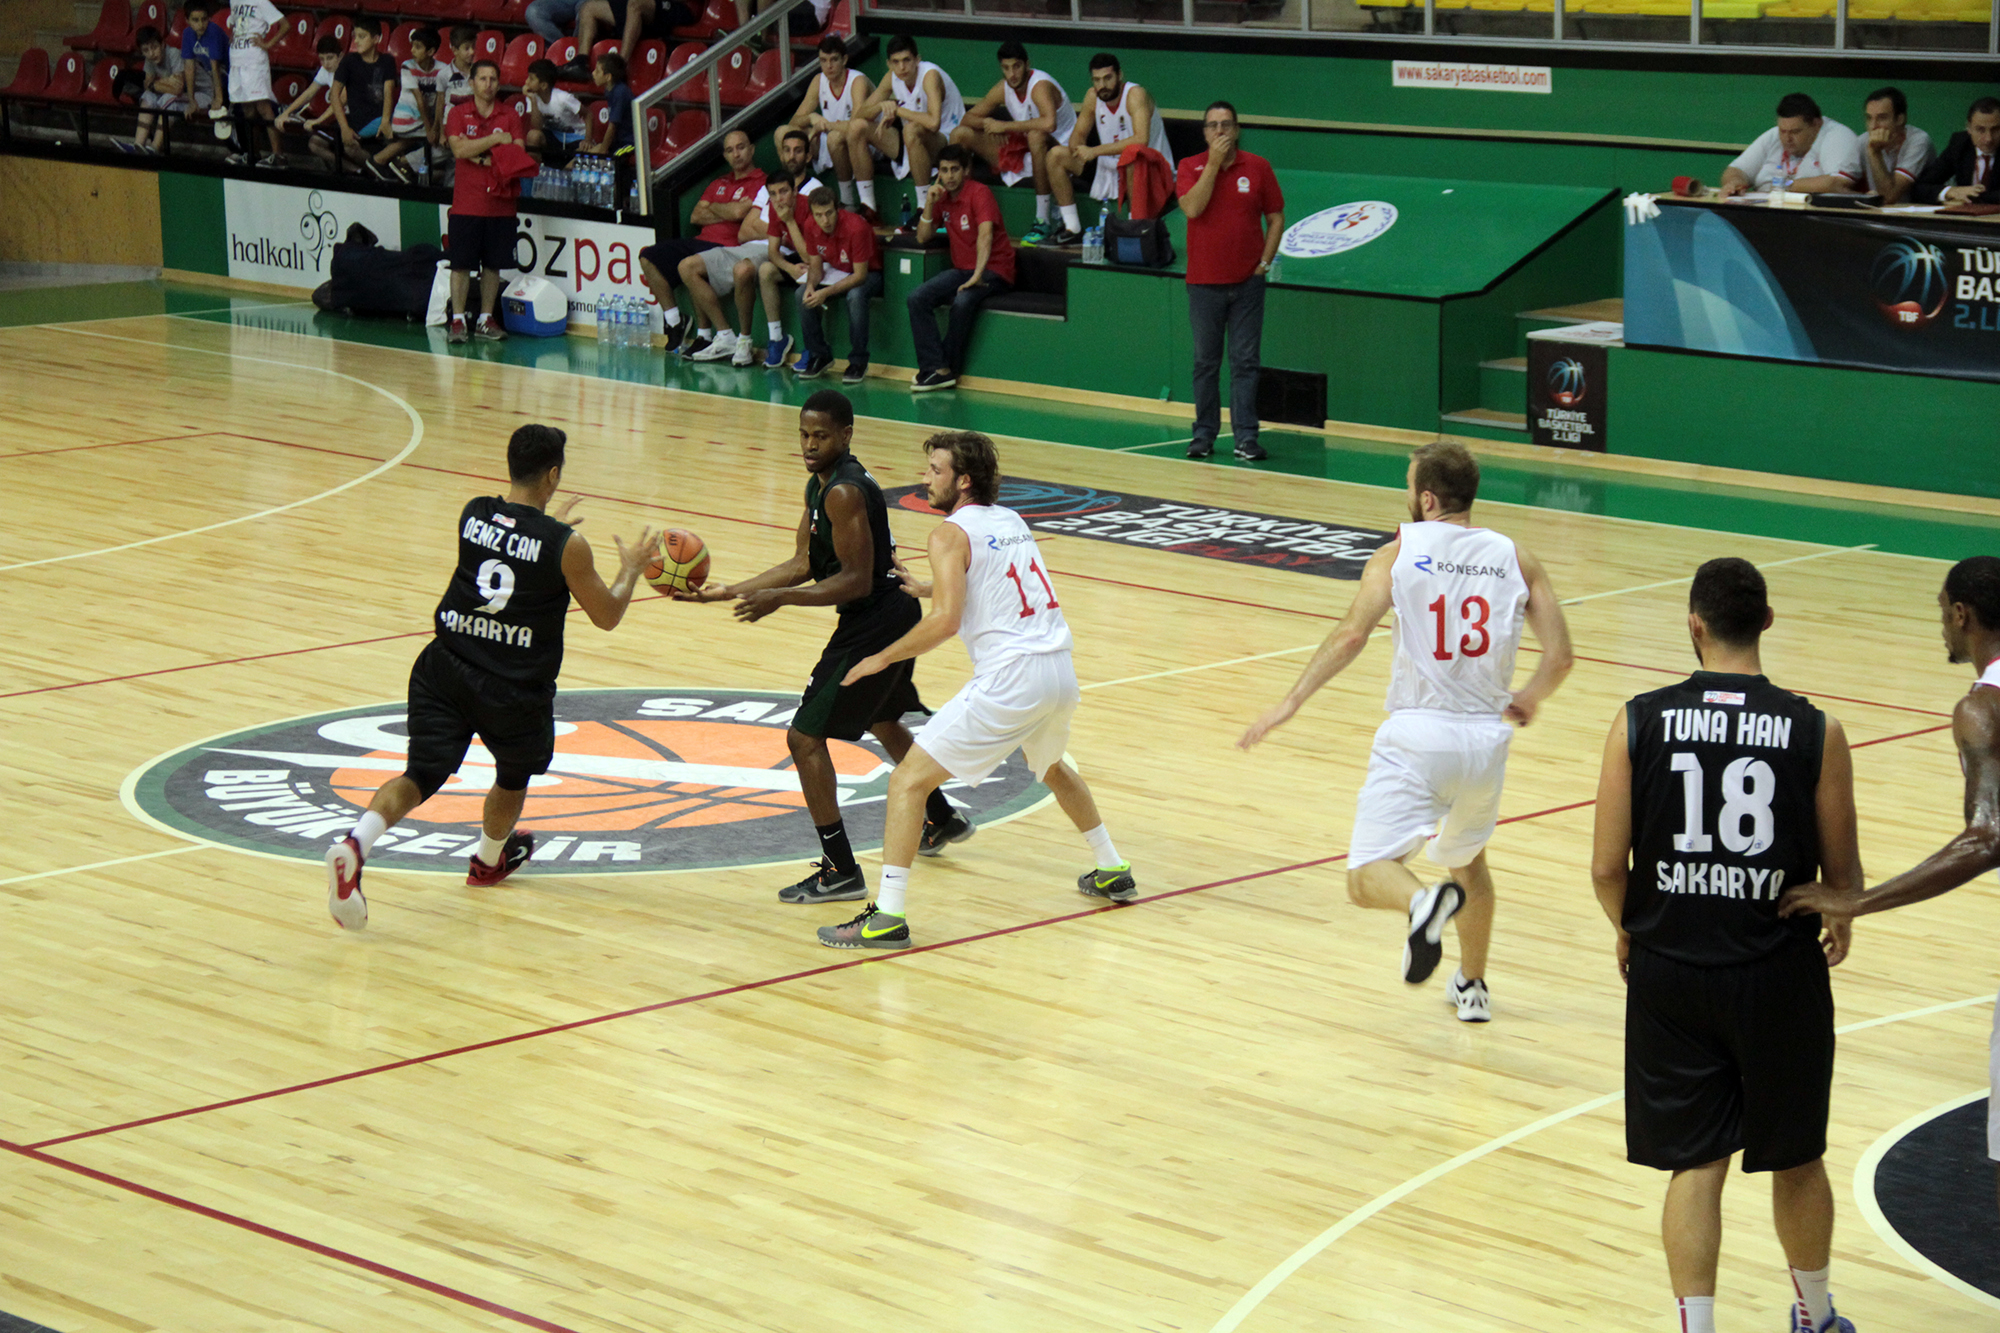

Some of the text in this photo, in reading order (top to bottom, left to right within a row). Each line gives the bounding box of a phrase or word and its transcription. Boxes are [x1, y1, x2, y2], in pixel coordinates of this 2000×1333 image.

[1396, 63, 1548, 87] www.sakaryabasketbol.com
[1956, 246, 2000, 275] TÜ
[1898, 310, 1919, 323] TBF
[1538, 418, 1595, 434] BASKETBOL
[1082, 511, 1376, 560] BASKETBO
[1141, 503, 1383, 544] TÜRKİYE
[506, 533, 542, 563] CAN
[473, 558, 515, 615] 9
[1006, 557, 1059, 618] 11
[1437, 561, 1506, 579] RÖNESANS
[1429, 594, 1490, 660] 13
[1661, 708, 1792, 749] TUNA HAN
[1670, 752, 1776, 856] 18
